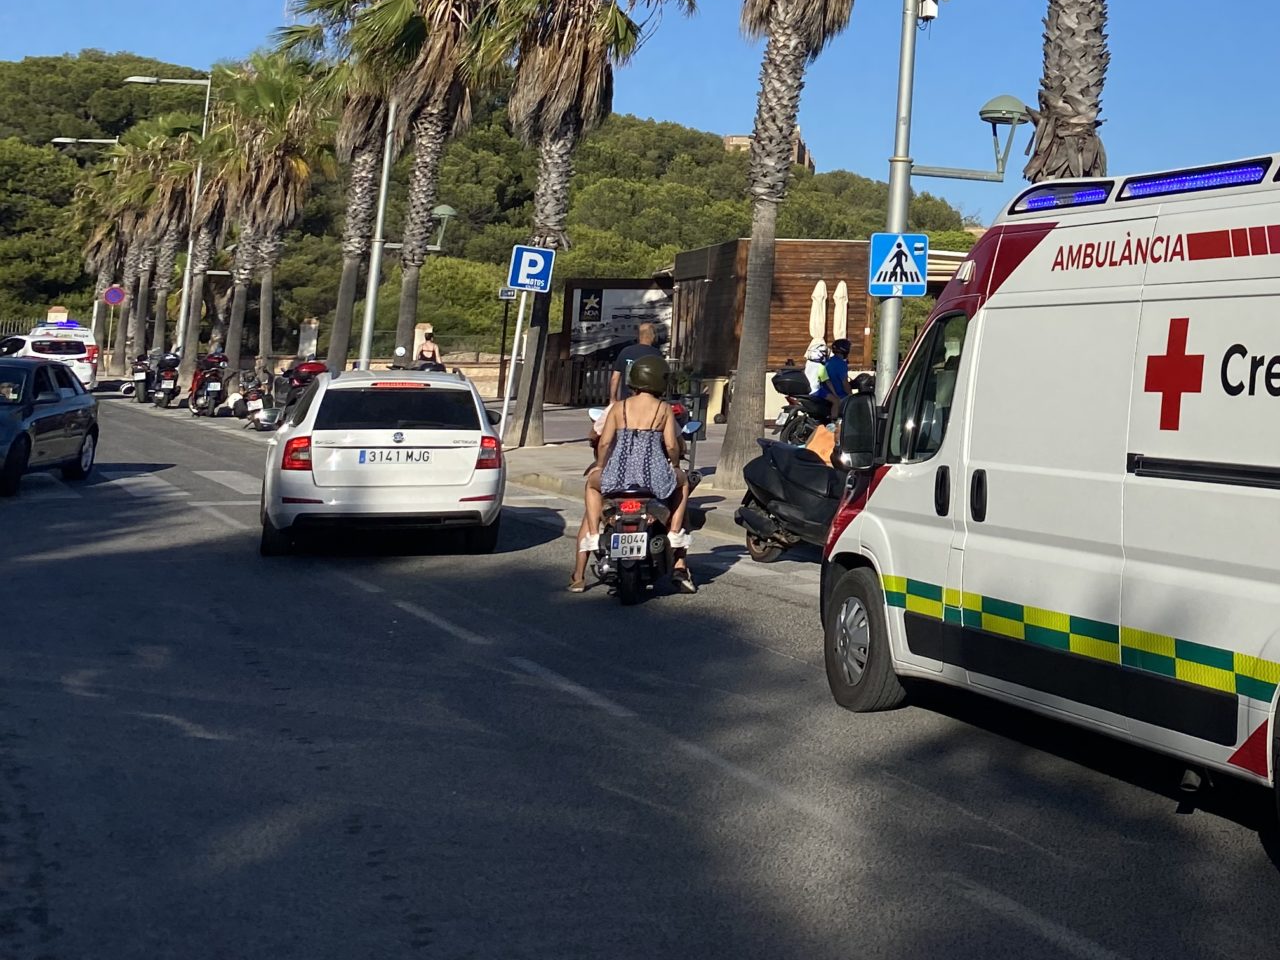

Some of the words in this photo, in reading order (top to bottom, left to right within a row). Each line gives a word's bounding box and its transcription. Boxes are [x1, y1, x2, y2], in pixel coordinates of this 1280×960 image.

[1051, 231, 1185, 271] AMBULÀNCIA
[518, 251, 545, 284] P
[369, 450, 400, 462] 3141
[405, 450, 430, 462] MJG
[621, 534, 645, 544] 8044
